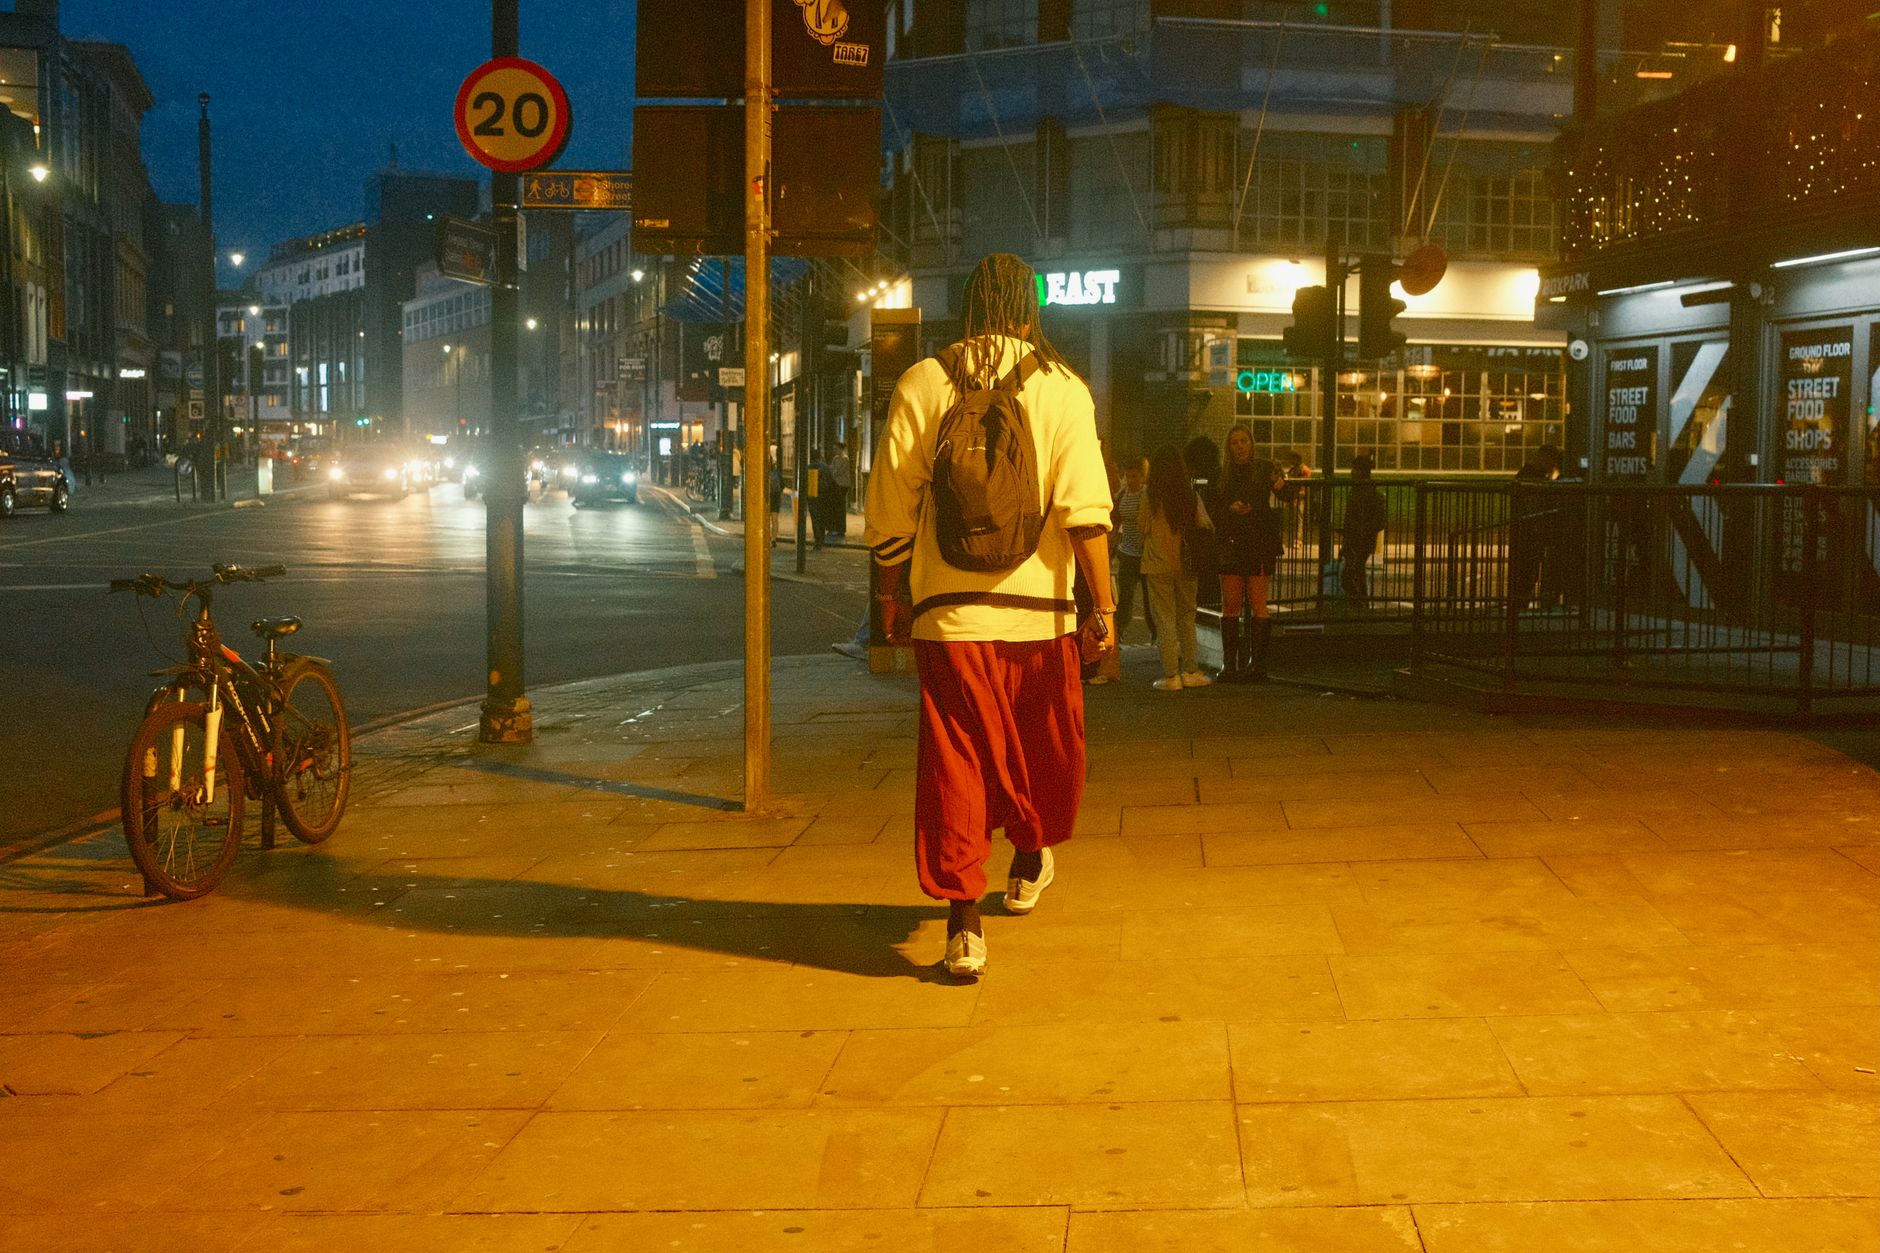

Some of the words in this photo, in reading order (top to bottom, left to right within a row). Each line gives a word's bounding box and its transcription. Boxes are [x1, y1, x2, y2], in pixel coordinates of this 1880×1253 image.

[472, 92, 549, 138] 20
[1046, 269, 1120, 306] EAST
[1543, 272, 1590, 296] BOXPARK
[1789, 345, 1822, 360] GROUND
[1823, 342, 1850, 357] FLOOR
[1610, 360, 1627, 372] FIRST
[1627, 358, 1648, 370] FLOOR
[1236, 370, 1295, 392] OPEN
[1788, 376, 1840, 400] STREET
[1610, 386, 1648, 406] STREET
[1609, 405, 1637, 424] FOOD
[1787, 399, 1825, 420] FOOD
[1608, 431, 1636, 449] BARS
[1786, 428, 1832, 450] SHOPS
[1607, 457, 1647, 475] EVENTS
[1785, 456, 1838, 471] ACCESSORIES
